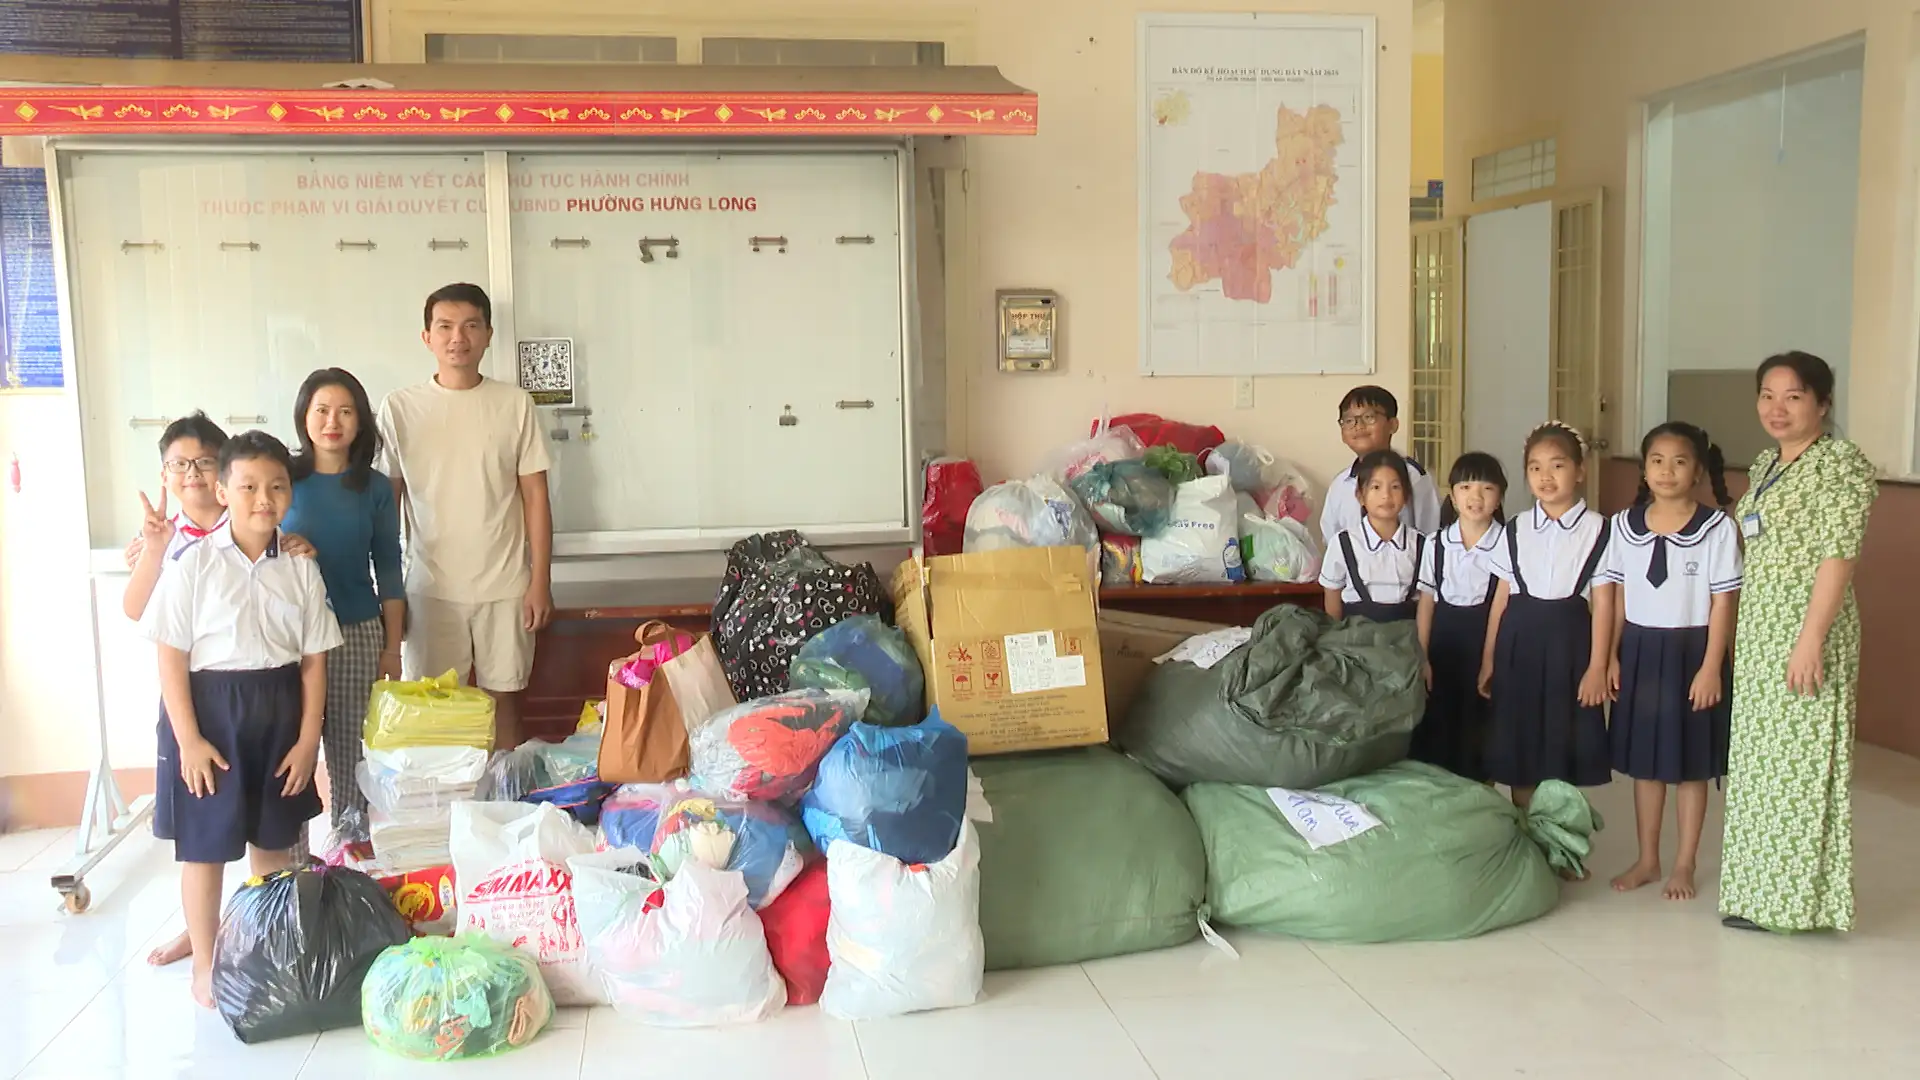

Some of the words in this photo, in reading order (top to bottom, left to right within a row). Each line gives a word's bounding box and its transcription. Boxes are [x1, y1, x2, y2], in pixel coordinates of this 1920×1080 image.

[297, 170, 349, 189] BẢNG
[410, 169, 445, 189] YẾT
[580, 170, 630, 187] HÀNH
[636, 170, 690, 187] CHÍNH
[271, 200, 326, 217] PHẠM
[332, 200, 349, 214] VI
[510, 199, 561, 213] UBND
[566, 194, 645, 212] PHƯỜNG
[650, 195, 702, 211] HƯNG
[708, 197, 757, 211] LONG
